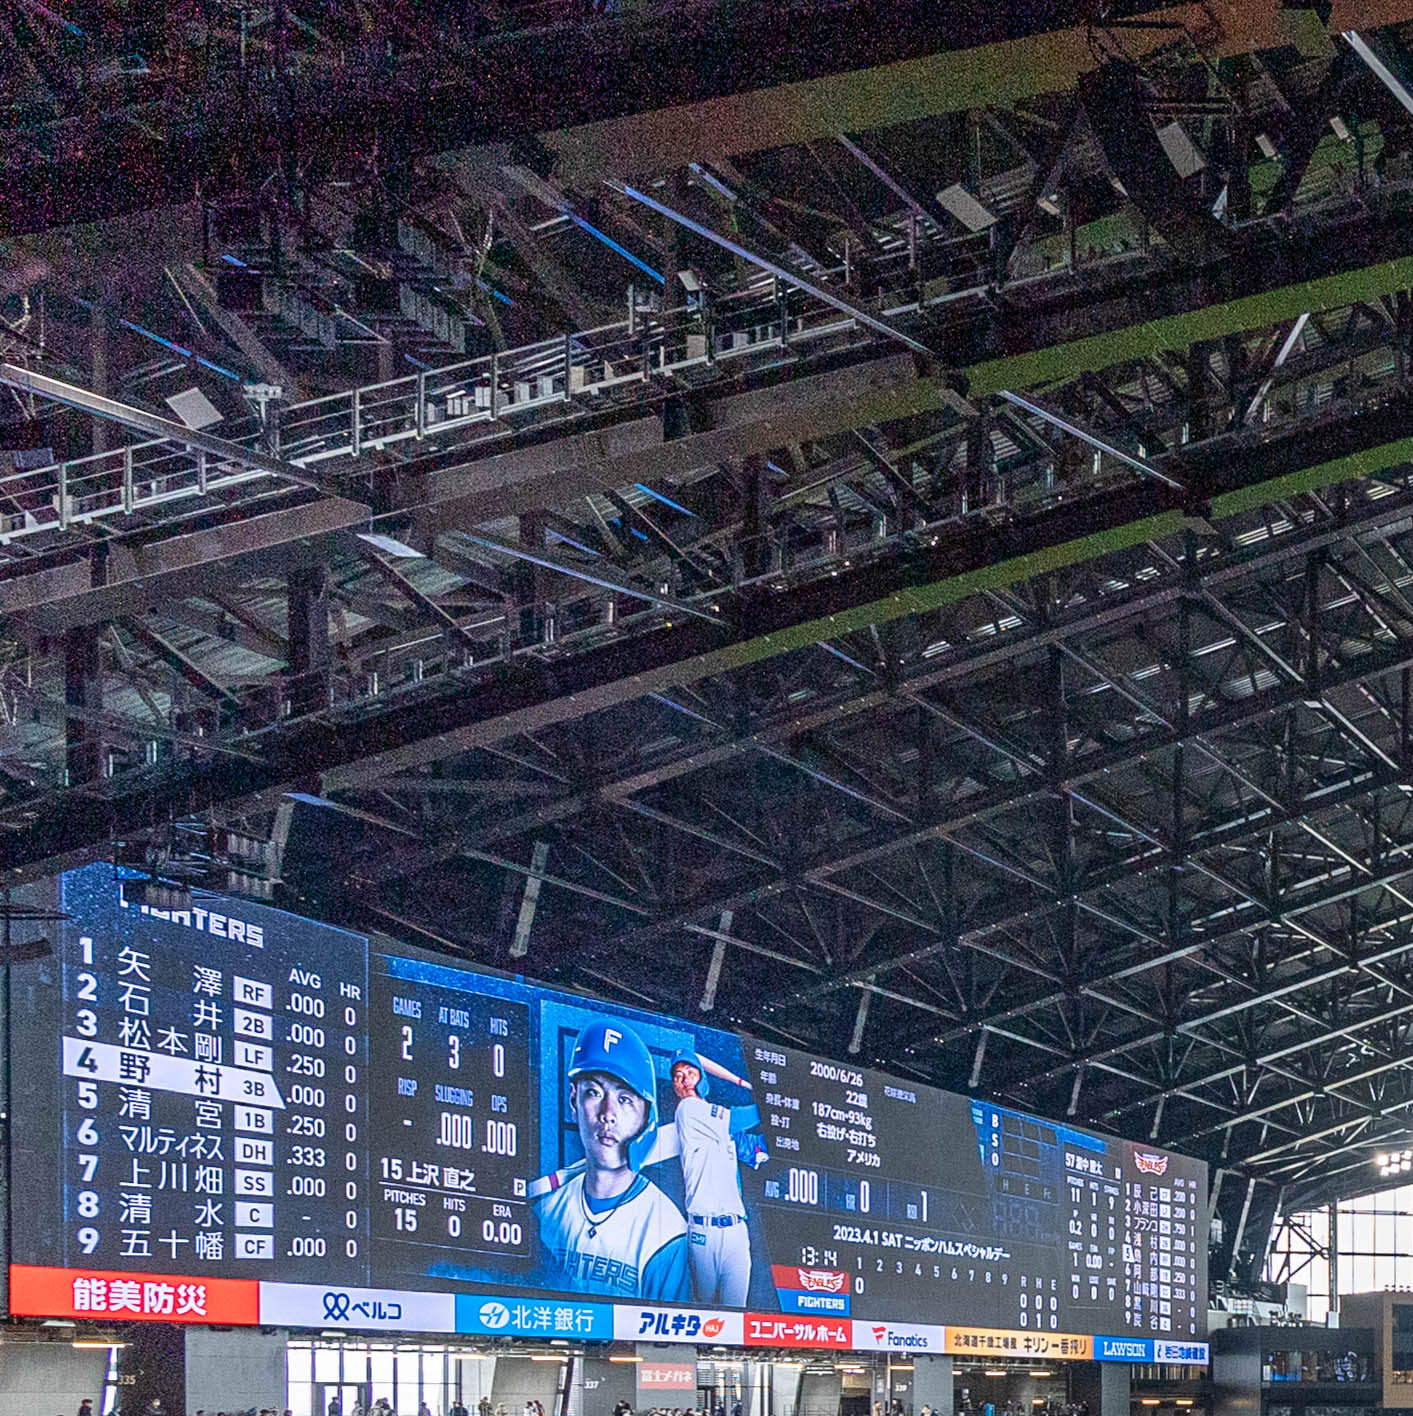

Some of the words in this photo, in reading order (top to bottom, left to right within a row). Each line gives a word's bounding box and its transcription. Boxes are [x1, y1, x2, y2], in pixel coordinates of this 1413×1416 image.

[118, 946, 223, 997] 矢澤
[289, 968, 321, 989] AVG
[340, 982, 361, 1001] HR
[119, 981, 223, 1030] 石井
[286, 992, 325, 1018] .000
[393, 997, 421, 1019] GAMES
[438, 1007, 448, 1023] AT
[450, 1009, 469, 1028] BATS
[490, 1018, 508, 1036] HITS
[119, 1017, 223, 1064] 松本剛
[286, 1029, 325, 1049] .000
[603, 1028, 622, 1053] F
[120, 1053, 222, 1095] 野村
[286, 1053, 325, 1078] .250
[810, 1061, 863, 1088] 2000/6/26
[286, 1084, 325, 1107] .000
[397, 1078, 417, 1097] RISP
[435, 1084, 473, 1107] SLUGGING
[119, 1087, 222, 1129] 清宮
[491, 1094, 507, 1113] OPS
[286, 1115, 326, 1138] .250
[436, 1112, 472, 1149] .000
[119, 1125, 223, 1161] マルティネス
[481, 1120, 517, 1157] .000
[286, 1146, 326, 1168] .333
[847, 1149, 881, 1168] アメリカ
[119, 1158, 223, 1195] 上川畑
[381, 1157, 403, 1180] 15
[406, 1161, 440, 1186] 上沢
[442, 1167, 476, 1192] 直之
[286, 1177, 326, 1198] .000
[384, 1188, 426, 1208] PITCHES
[119, 1192, 223, 1227] 清水
[443, 1198, 466, 1212] HITS
[492, 1204, 513, 1219] ERA
[394, 1207, 417, 1232] 15
[482, 1219, 522, 1245] 0.00
[833, 1224, 878, 1248] 2023.4.1
[882, 1232, 903, 1248] SAT
[120, 1230, 223, 1260] 五十幡
[286, 1238, 327, 1258] .000
[73, 1277, 207, 1316] 能美防災
[797, 1295, 845, 1310] FIGHTERS
[351, 1301, 402, 1321] ベルコ
[511, 1305, 594, 1332] 北洋銀行
[639, 1312, 701, 1336] アルキタ
[888, 1332, 928, 1348] Fanatics
[1103, 1341, 1145, 1357] LAWSON
